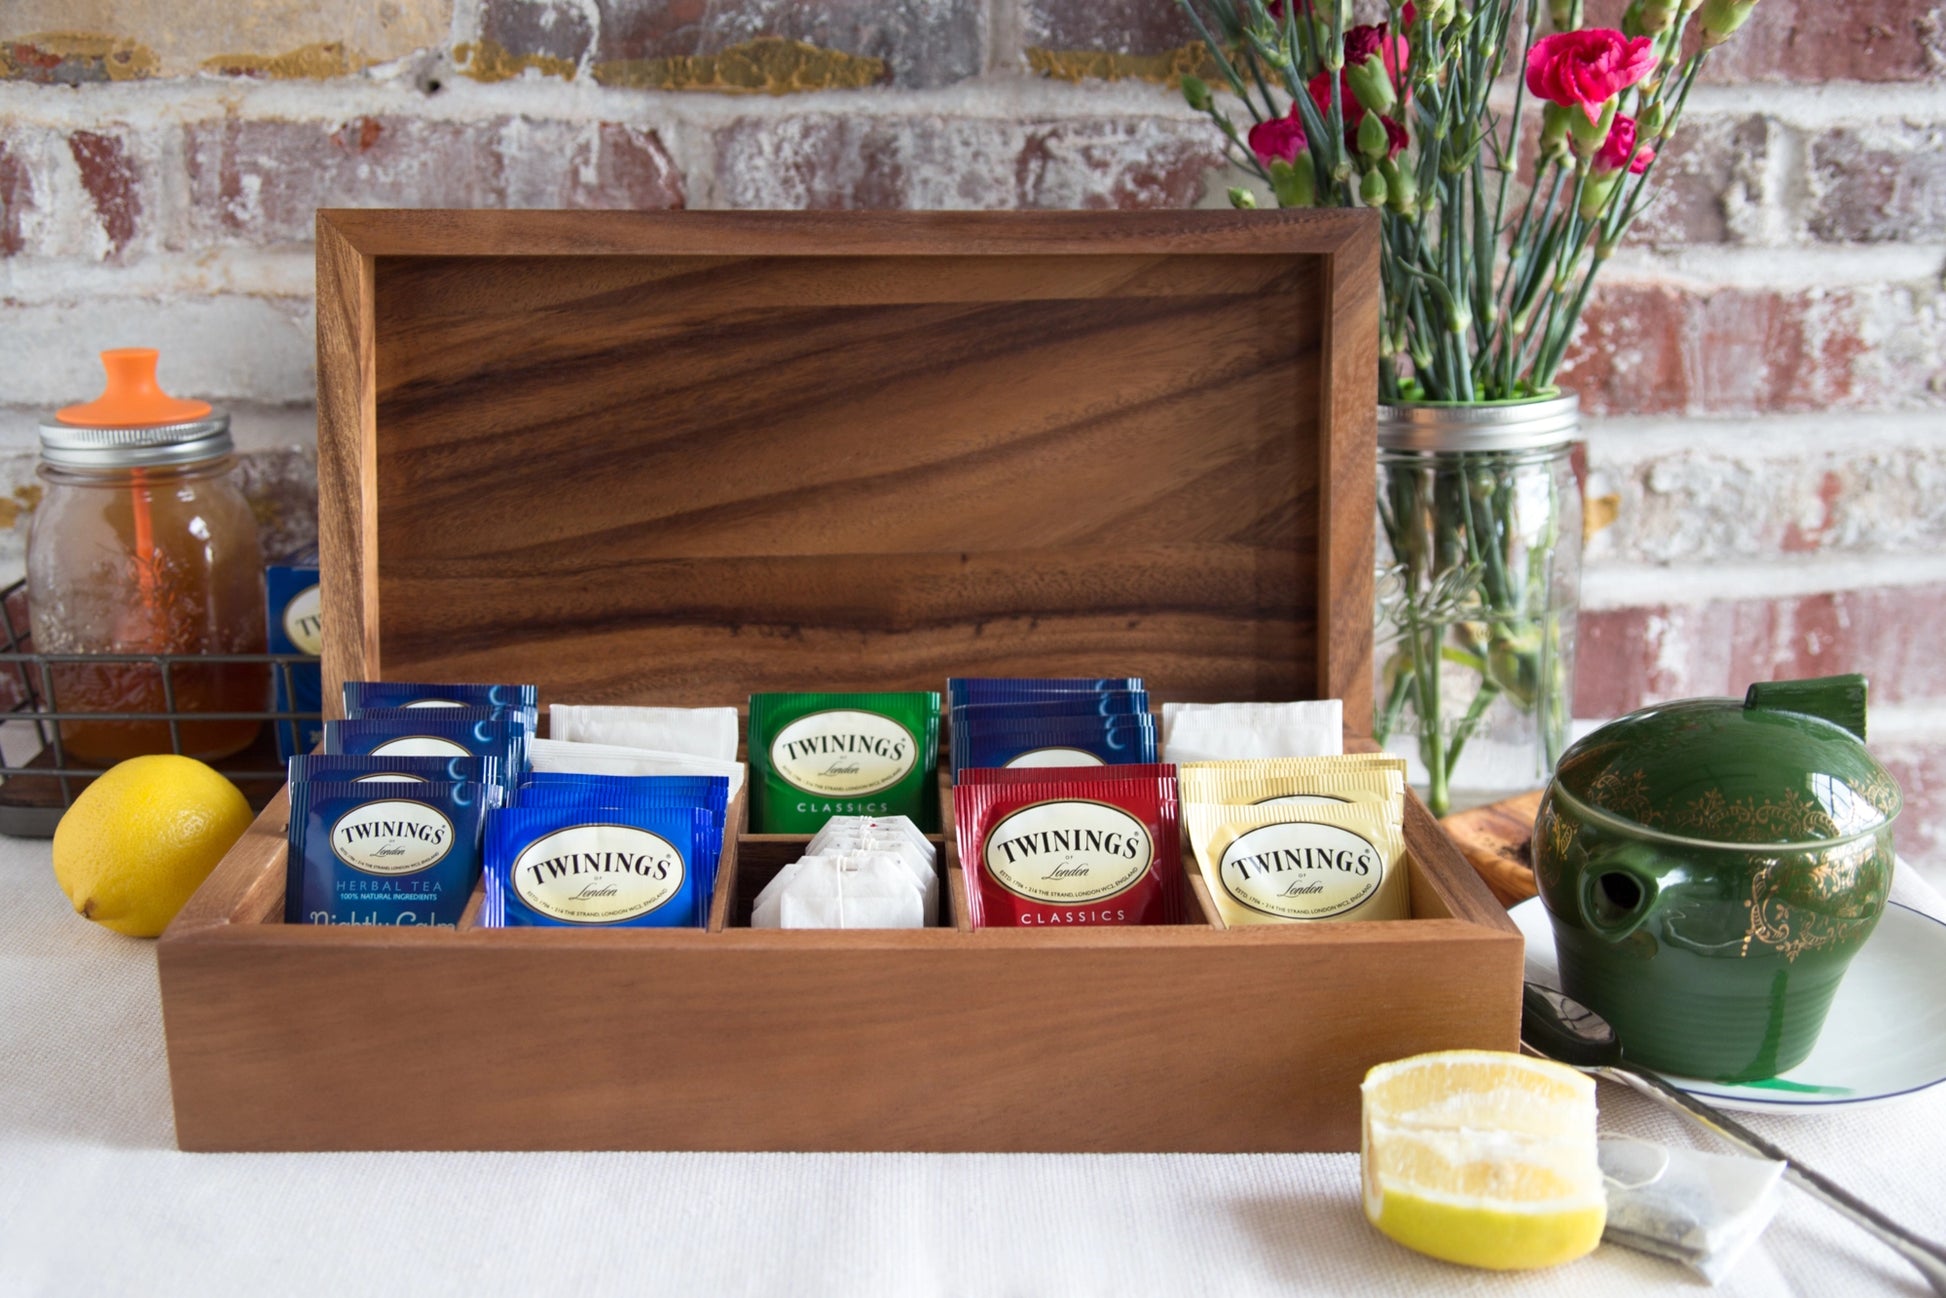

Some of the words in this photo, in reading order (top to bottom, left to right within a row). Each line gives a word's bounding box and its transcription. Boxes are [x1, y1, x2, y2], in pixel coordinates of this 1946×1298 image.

[783, 734, 906, 761] TWININGS
[817, 761, 860, 777] London
[797, 803, 888, 813] CLASSICS
[341, 821, 445, 845] TWININGS
[369, 844, 406, 858] London
[997, 829, 1140, 865] TWININGS
[527, 852, 671, 886] TWININGS
[1041, 861, 1090, 881] London
[1231, 848, 1371, 881] TWININGS
[336, 881, 401, 892] HERBAL
[411, 881, 442, 892] TEA
[568, 882, 618, 901] London
[1038, 889, 1049, 897] THE
[1075, 889, 1101, 898] LONDON
[1115, 866, 1138, 887] ENGLAND
[1276, 879, 1324, 899] London
[361, 893, 391, 901] NATURAL
[393, 893, 438, 901] INGREDIENTS
[1310, 906, 1337, 914] LONDON
[1350, 883, 1373, 902] ENGLAND
[1021, 910, 1125, 924] CLASSICS
